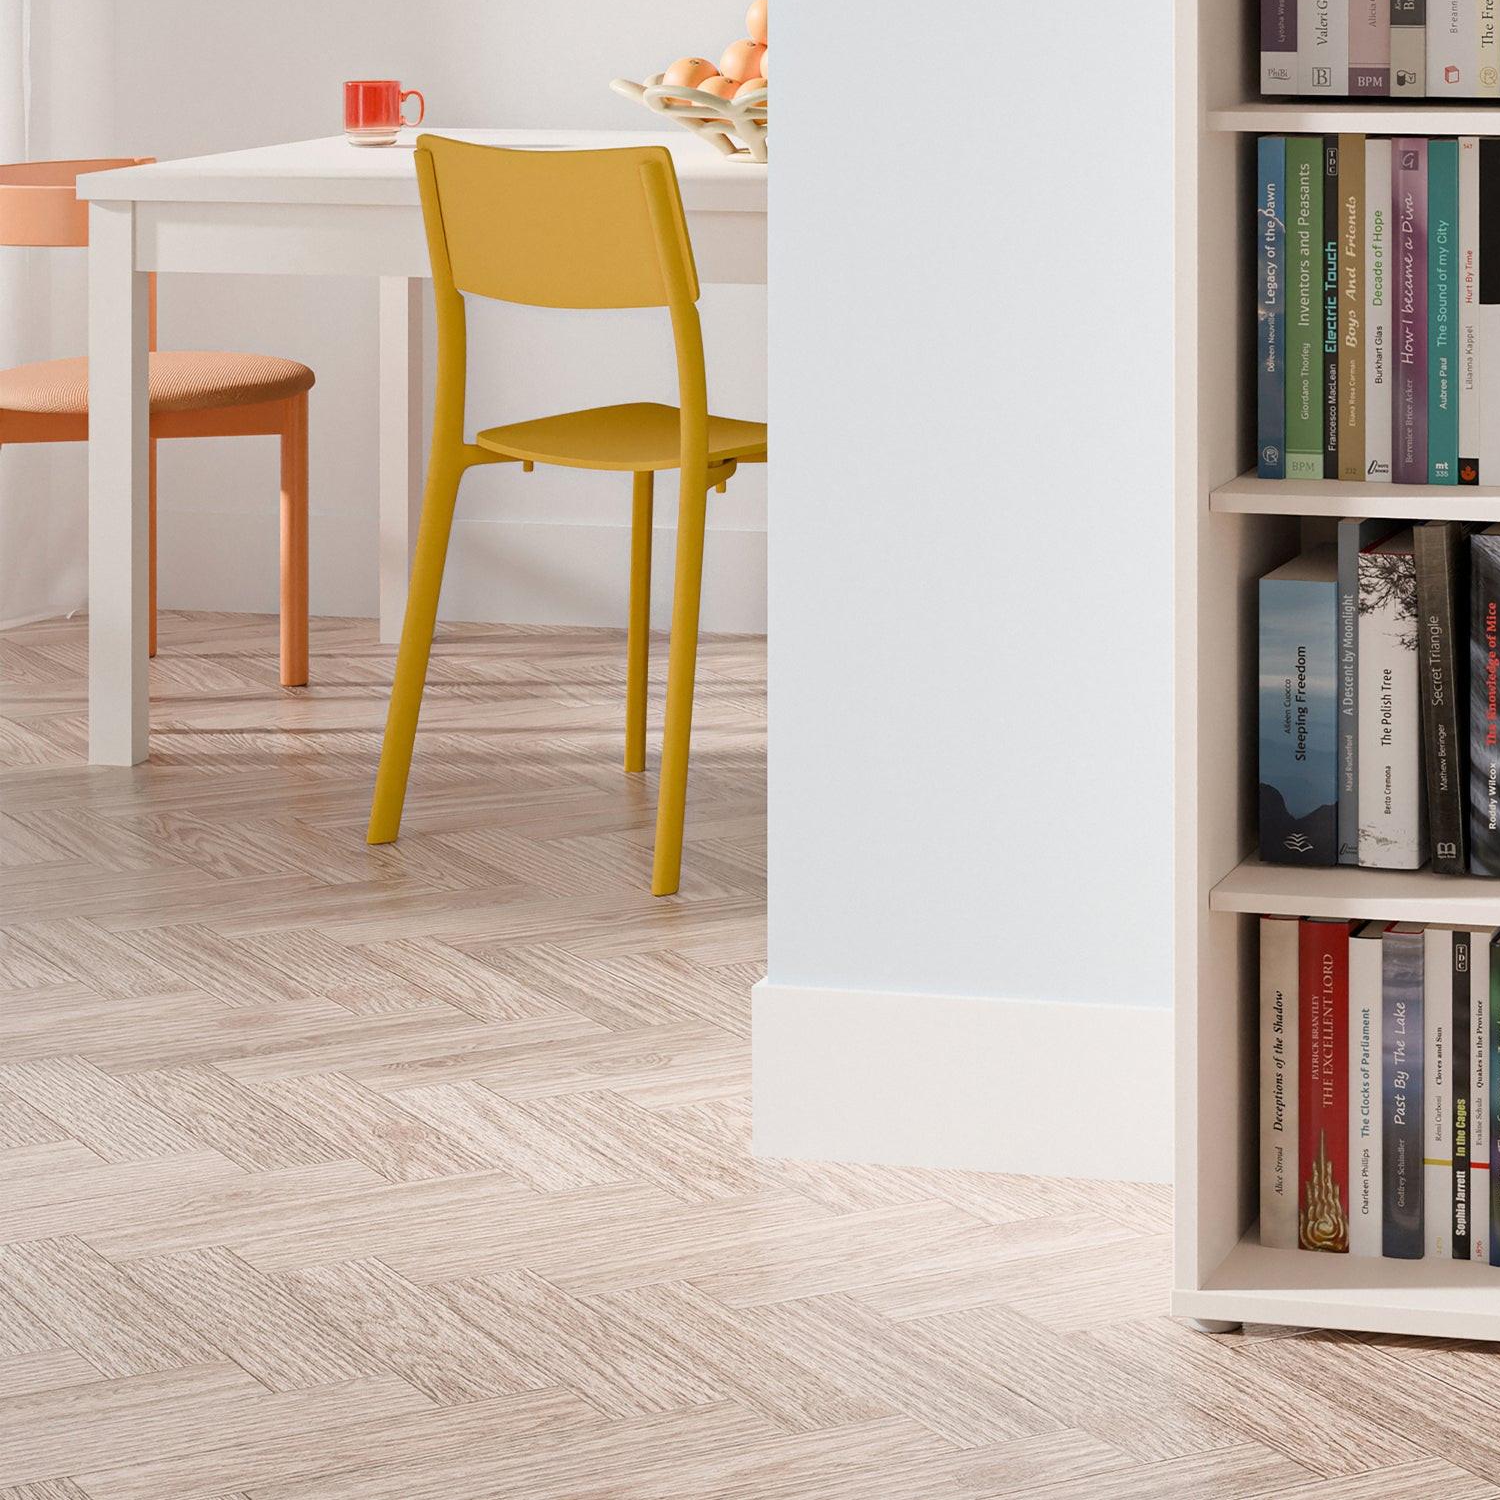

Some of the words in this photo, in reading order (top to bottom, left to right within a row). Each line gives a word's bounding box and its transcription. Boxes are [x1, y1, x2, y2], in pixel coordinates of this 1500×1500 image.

[1317, 12, 1328, 45] Valeri
[1481, 24, 1493, 48] The
[1358, 76, 1383, 87] BPM
[1266, 184, 1275, 216] Dawn
[1298, 163, 1310, 226] Peasants
[1265, 221, 1275, 241] the
[1374, 210, 1384, 242] Hope
[1437, 220, 1449, 244] City
[1265, 245, 1275, 258] of
[1298, 231, 1310, 256] and
[1373, 245, 1382, 258] of
[1440, 248, 1449, 265] my
[1325, 242, 1337, 290] Touch
[1437, 268, 1447, 280] of
[1265, 261, 1278, 304] Legacy
[1298, 260, 1310, 326] Inventors
[1373, 261, 1382, 306] Decade
[1437, 284, 1447, 322] Sound
[1325, 297, 1337, 353] Electric
[1437, 325, 1447, 347] The
[1428, 616, 1441, 665] Triangle
[1295, 646, 1306, 702] Freedom
[1381, 669, 1391, 691] Tree
[1431, 668, 1443, 705] Secret
[1381, 694, 1391, 725] Polish
[1296, 707, 1307, 760] Sleeping
[1382, 728, 1391, 746] The
[1488, 763, 1496, 795] Wilcox
[1489, 798, 1497, 829] Roddy
[1323, 954, 1333, 994] LORD
[1273, 991, 1283, 1033] Shadow
[1273, 1037, 1283, 1054] the
[1323, 997, 1333, 1074] EXCELLENT
[1361, 1009, 1369, 1065] Parliament
[1273, 1055, 1285, 1069] of
[1361, 1067, 1369, 1079] of
[1273, 1073, 1285, 1131] Deceptions
[1323, 1079, 1333, 1107] THE
[1361, 1082, 1369, 1115] Clocks
[1361, 1119, 1369, 1138] The
[1456, 1099, 1466, 1128] Cages
[1456, 1130, 1465, 1145] the
[1456, 1147, 1465, 1156] In
[1456, 1171, 1465, 1201] Jarrett
[1456, 1203, 1467, 1235] Sophia
